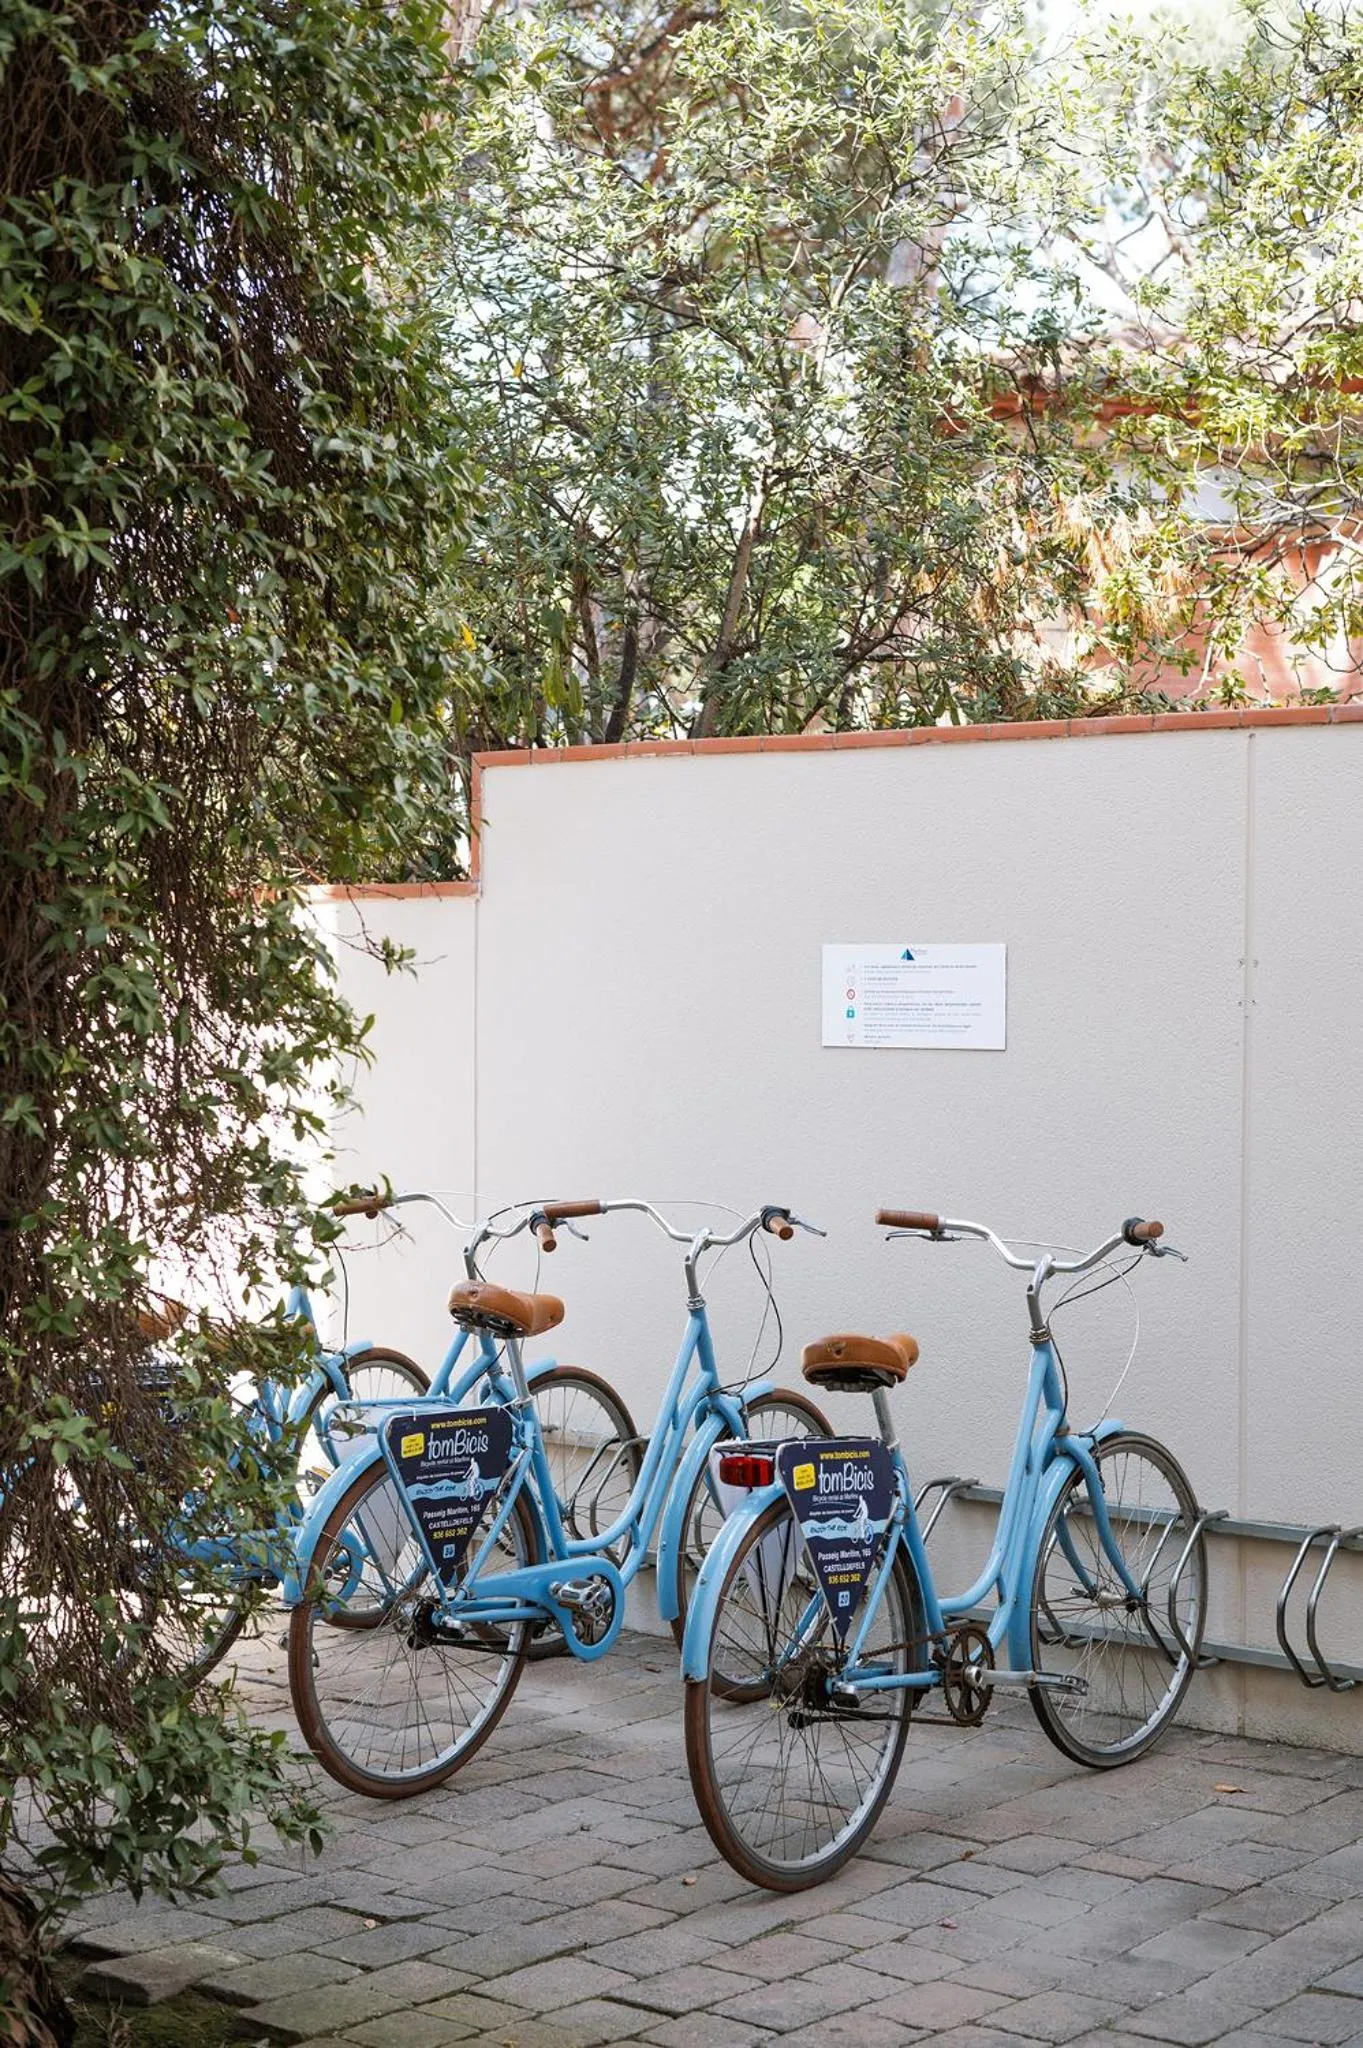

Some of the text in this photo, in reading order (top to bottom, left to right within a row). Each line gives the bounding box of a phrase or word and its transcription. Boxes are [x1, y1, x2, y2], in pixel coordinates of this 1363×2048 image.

[431, 1417, 487, 1429] www.tombicis.com
[428, 1429, 488, 1460] tomBicis
[820, 1450, 871, 1460] www.tombicis.com
[818, 1462, 875, 1494] tomBicis
[423, 1509, 446, 1519] Passeig
[428, 1516, 474, 1530] CASTELLDEFELS
[818, 1551, 839, 1561] Passeig
[823, 1561, 865, 1573] CASTELLDEFELS
